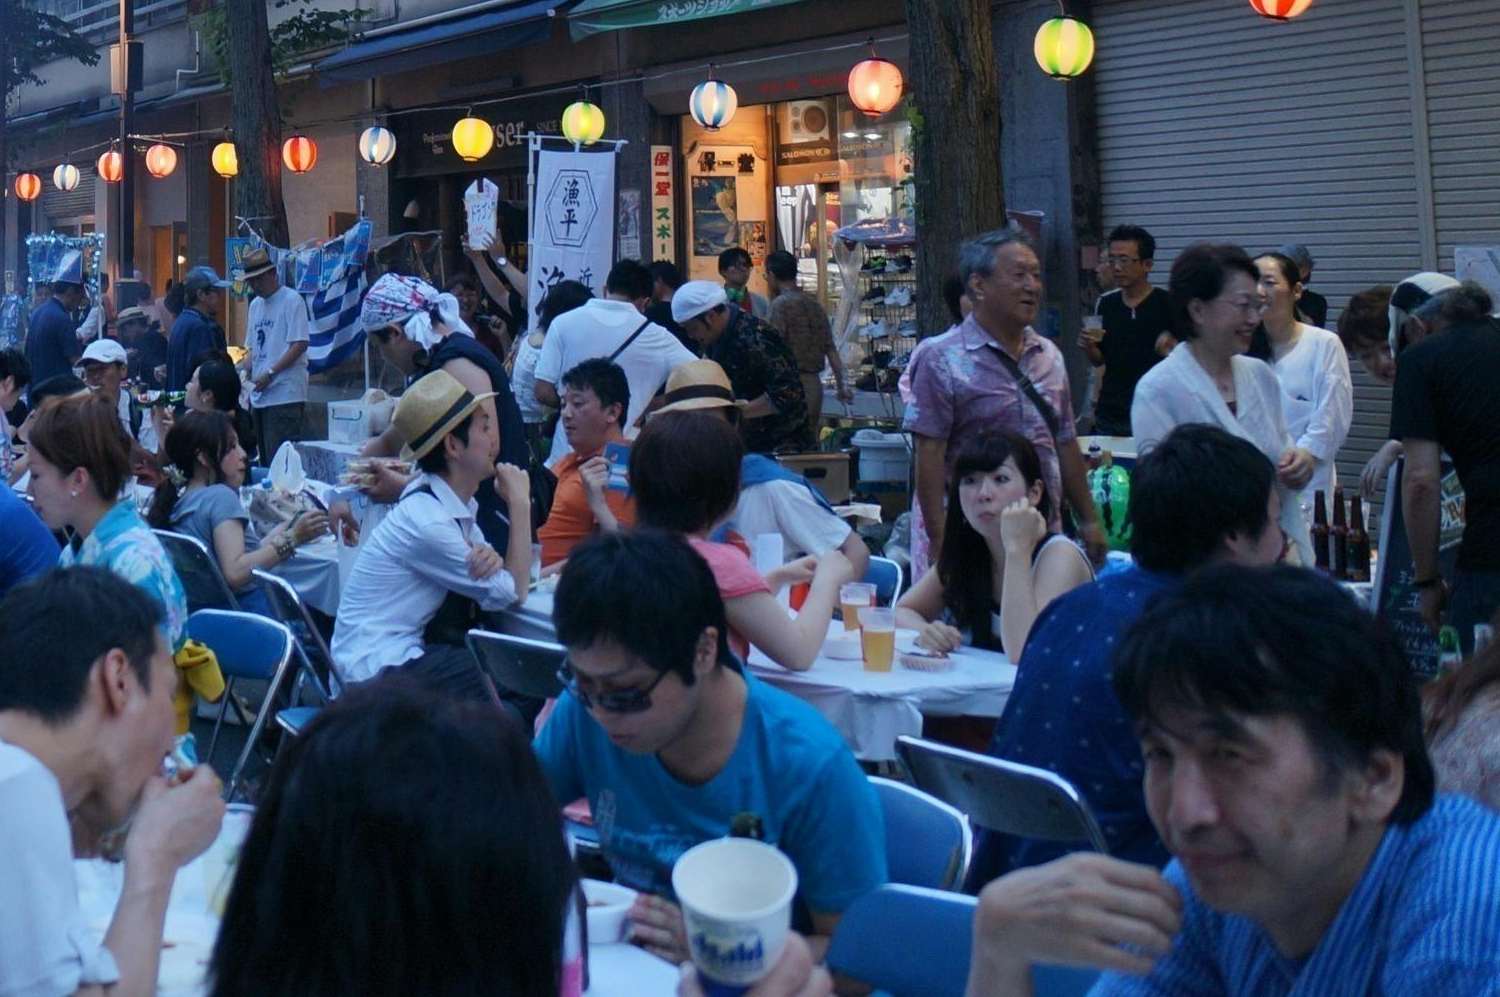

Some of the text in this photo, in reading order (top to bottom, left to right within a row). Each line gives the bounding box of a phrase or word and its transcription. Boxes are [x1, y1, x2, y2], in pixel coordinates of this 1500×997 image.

[698, 151, 755, 173] 保一堂
[781, 149, 815, 158] SALOMON
[655, 152, 671, 196] 保一堂
[560, 178, 580, 237] 漁平
